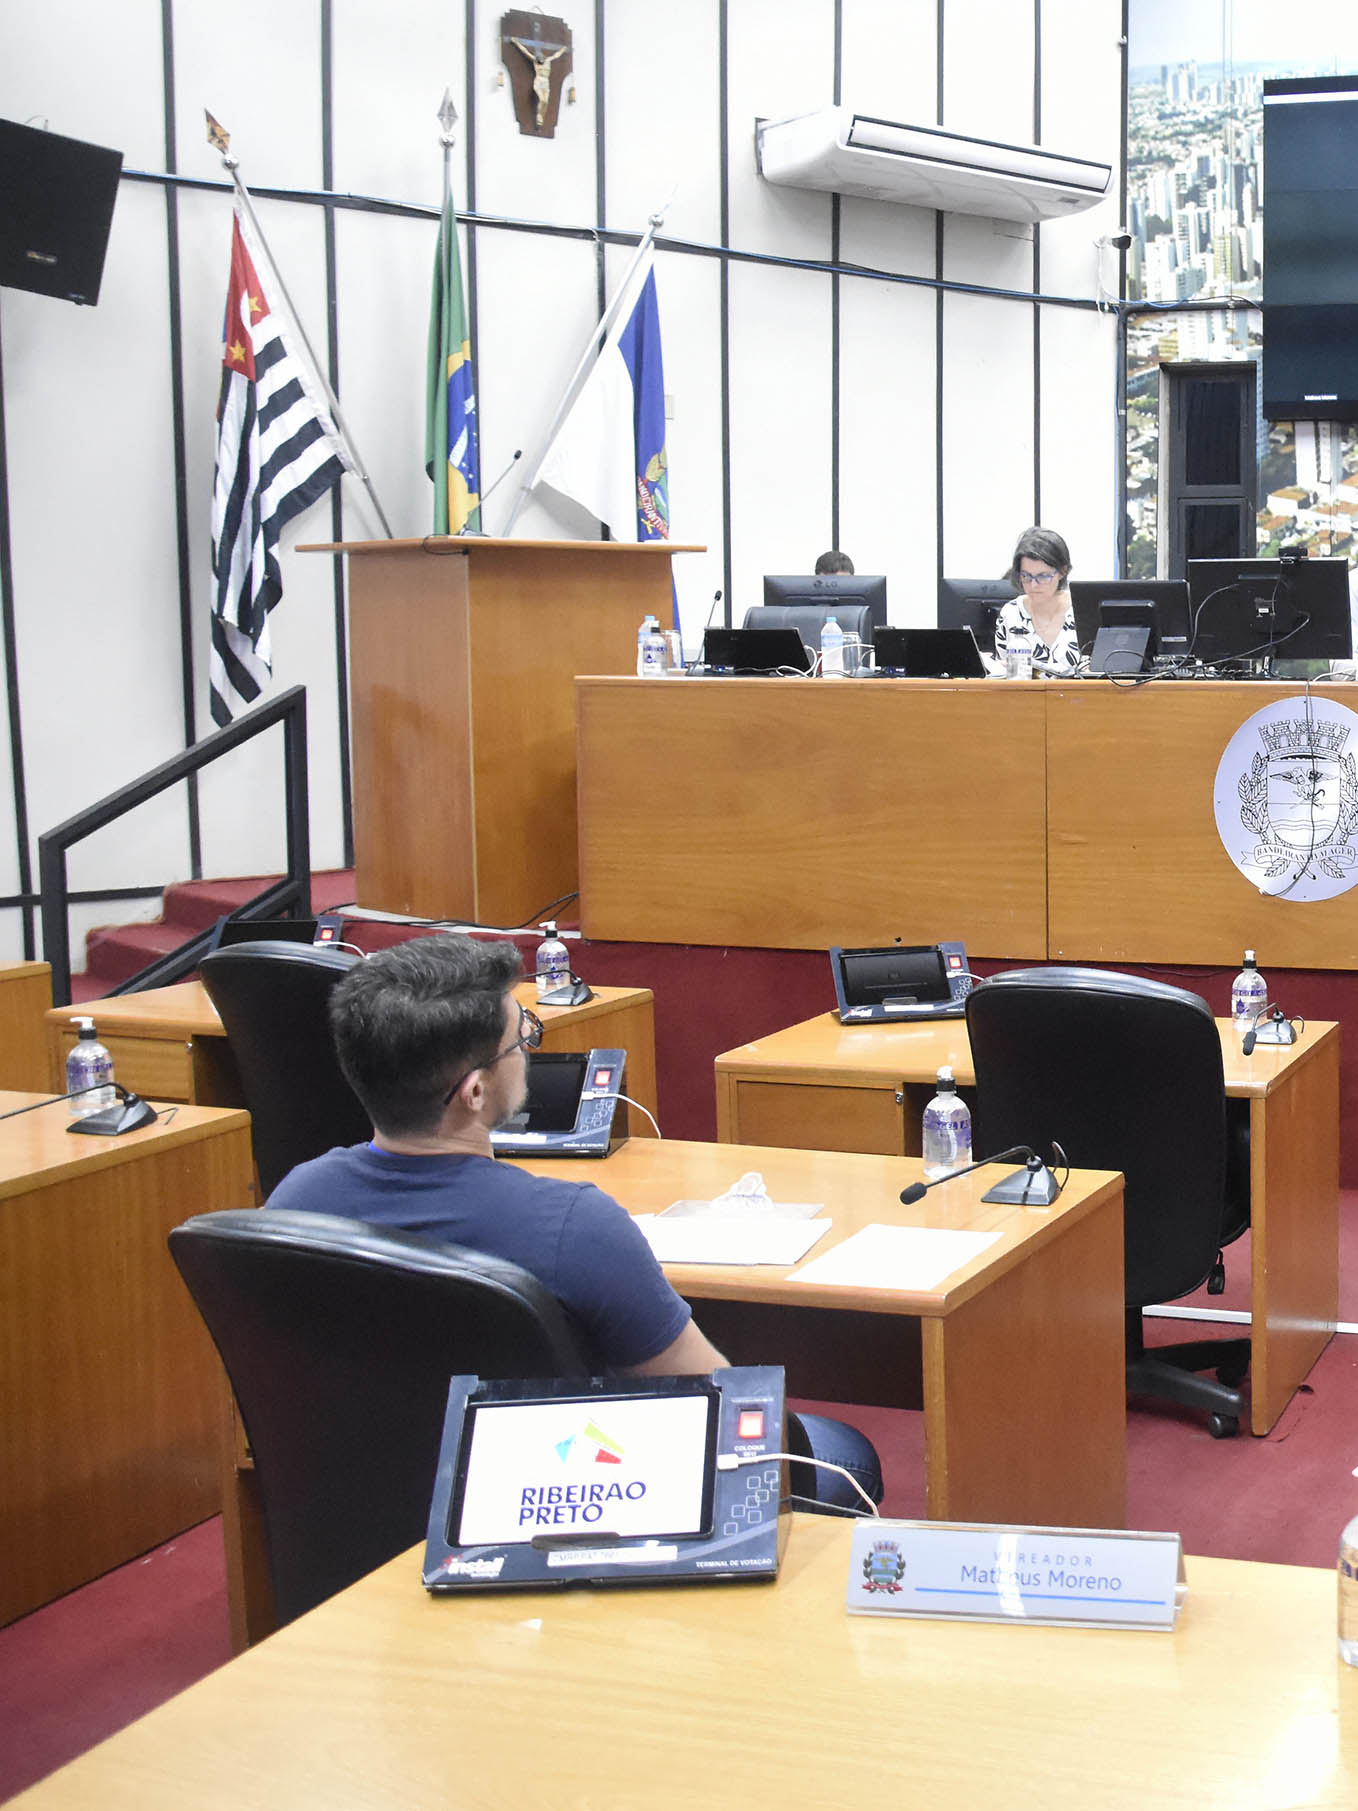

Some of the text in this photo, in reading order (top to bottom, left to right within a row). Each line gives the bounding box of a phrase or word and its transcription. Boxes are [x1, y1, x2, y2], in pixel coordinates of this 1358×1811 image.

[519, 1503, 603, 1526] PRETO
[960, 1565, 1122, 1591] Mateus Moreno
